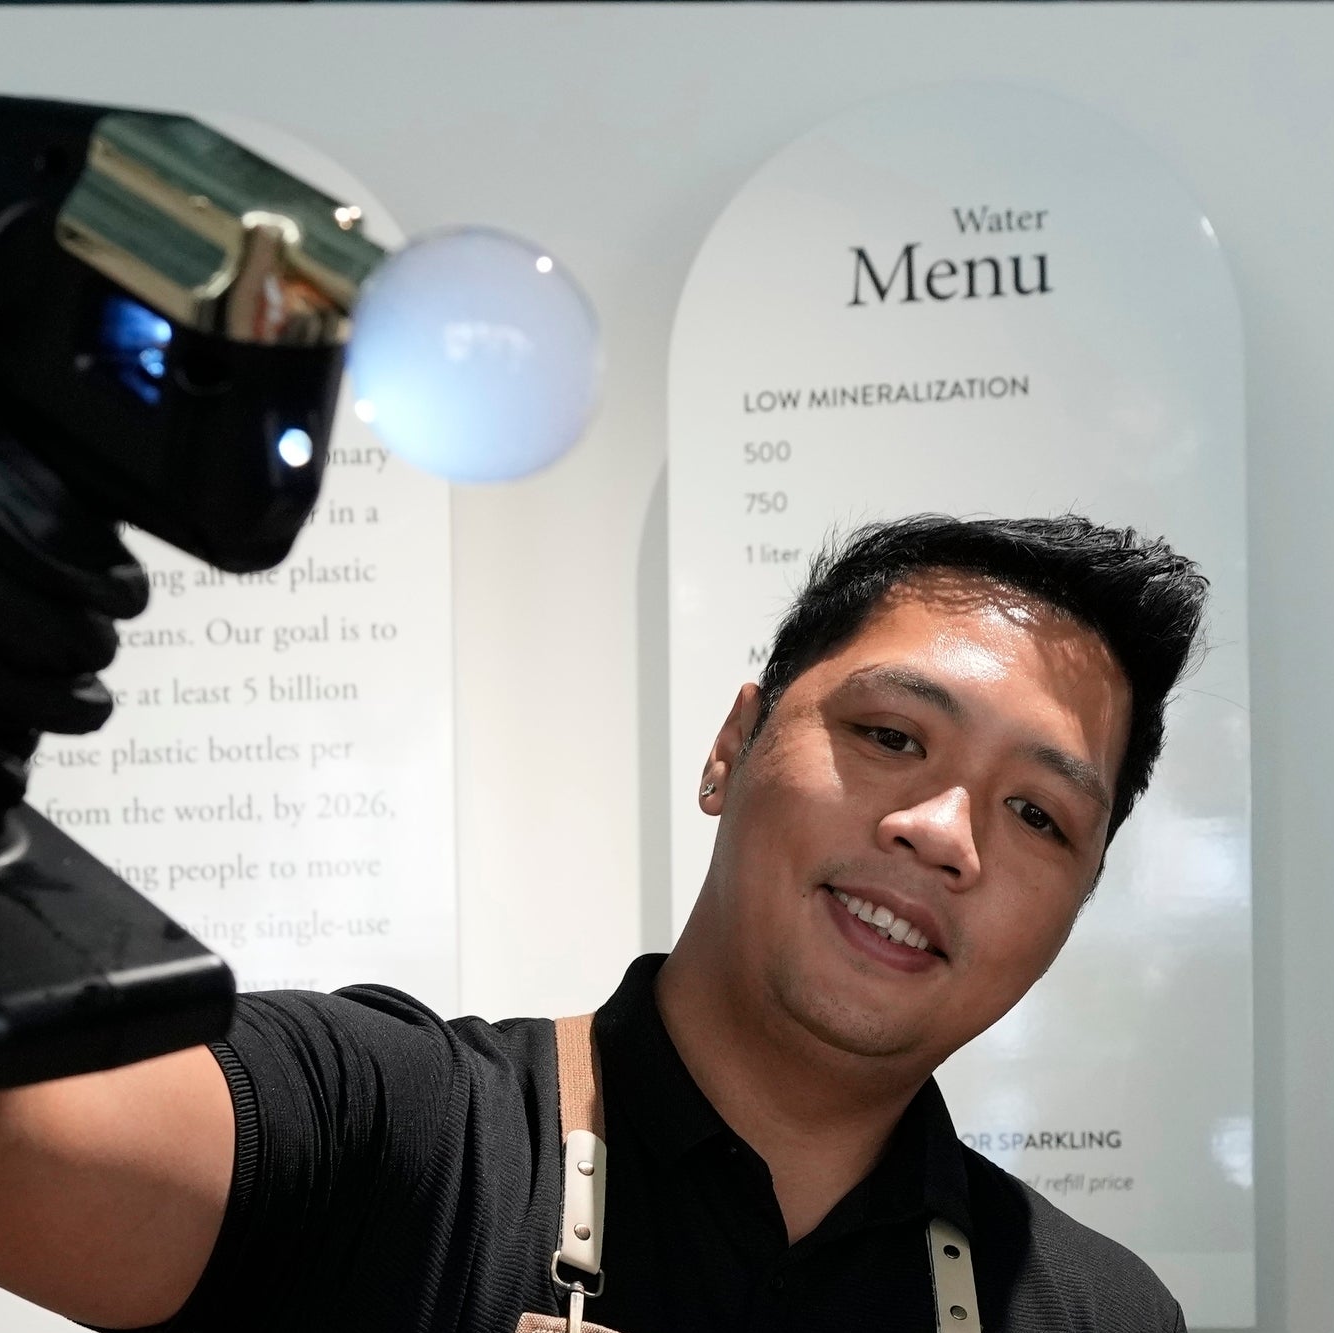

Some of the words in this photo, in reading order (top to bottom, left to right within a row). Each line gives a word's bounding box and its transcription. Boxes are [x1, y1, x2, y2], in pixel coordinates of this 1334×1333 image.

[952, 205, 1049, 234] Water
[847, 242, 1054, 307] Menu
[744, 389, 800, 414] LOW
[807, 375, 1030, 410] MINERALIZATION
[743, 440, 792, 464] 500
[328, 500, 354, 525] in
[365, 505, 379, 524] a
[744, 491, 788, 515] 750
[745, 545, 754, 563] 1
[760, 544, 802, 564] liter
[290, 558, 377, 593] plastic
[205, 618, 266, 646] Our
[273, 614, 330, 652] goal
[339, 617, 360, 642] is
[370, 620, 398, 641] to
[137, 683, 161, 706] at
[173, 678, 231, 706] least
[243, 677, 258, 703] 5
[269, 675, 359, 704] billion
[112, 738, 198, 774] plastic
[209, 736, 300, 764] bottles
[310, 739, 355, 769] per
[45, 797, 111, 827] from
[123, 797, 165, 825] the
[175, 793, 263, 824] world,
[273, 793, 307, 829] by
[316, 790, 397, 822] 2026,
[168, 853, 259, 890] people
[269, 861, 296, 880] to
[307, 857, 382, 880] move
[255, 911, 391, 948] single-use
[999, 1130, 1123, 1150] SPARKLING
[1045, 1173, 1085, 1196] refill
[1088, 1175, 1134, 1195] price
